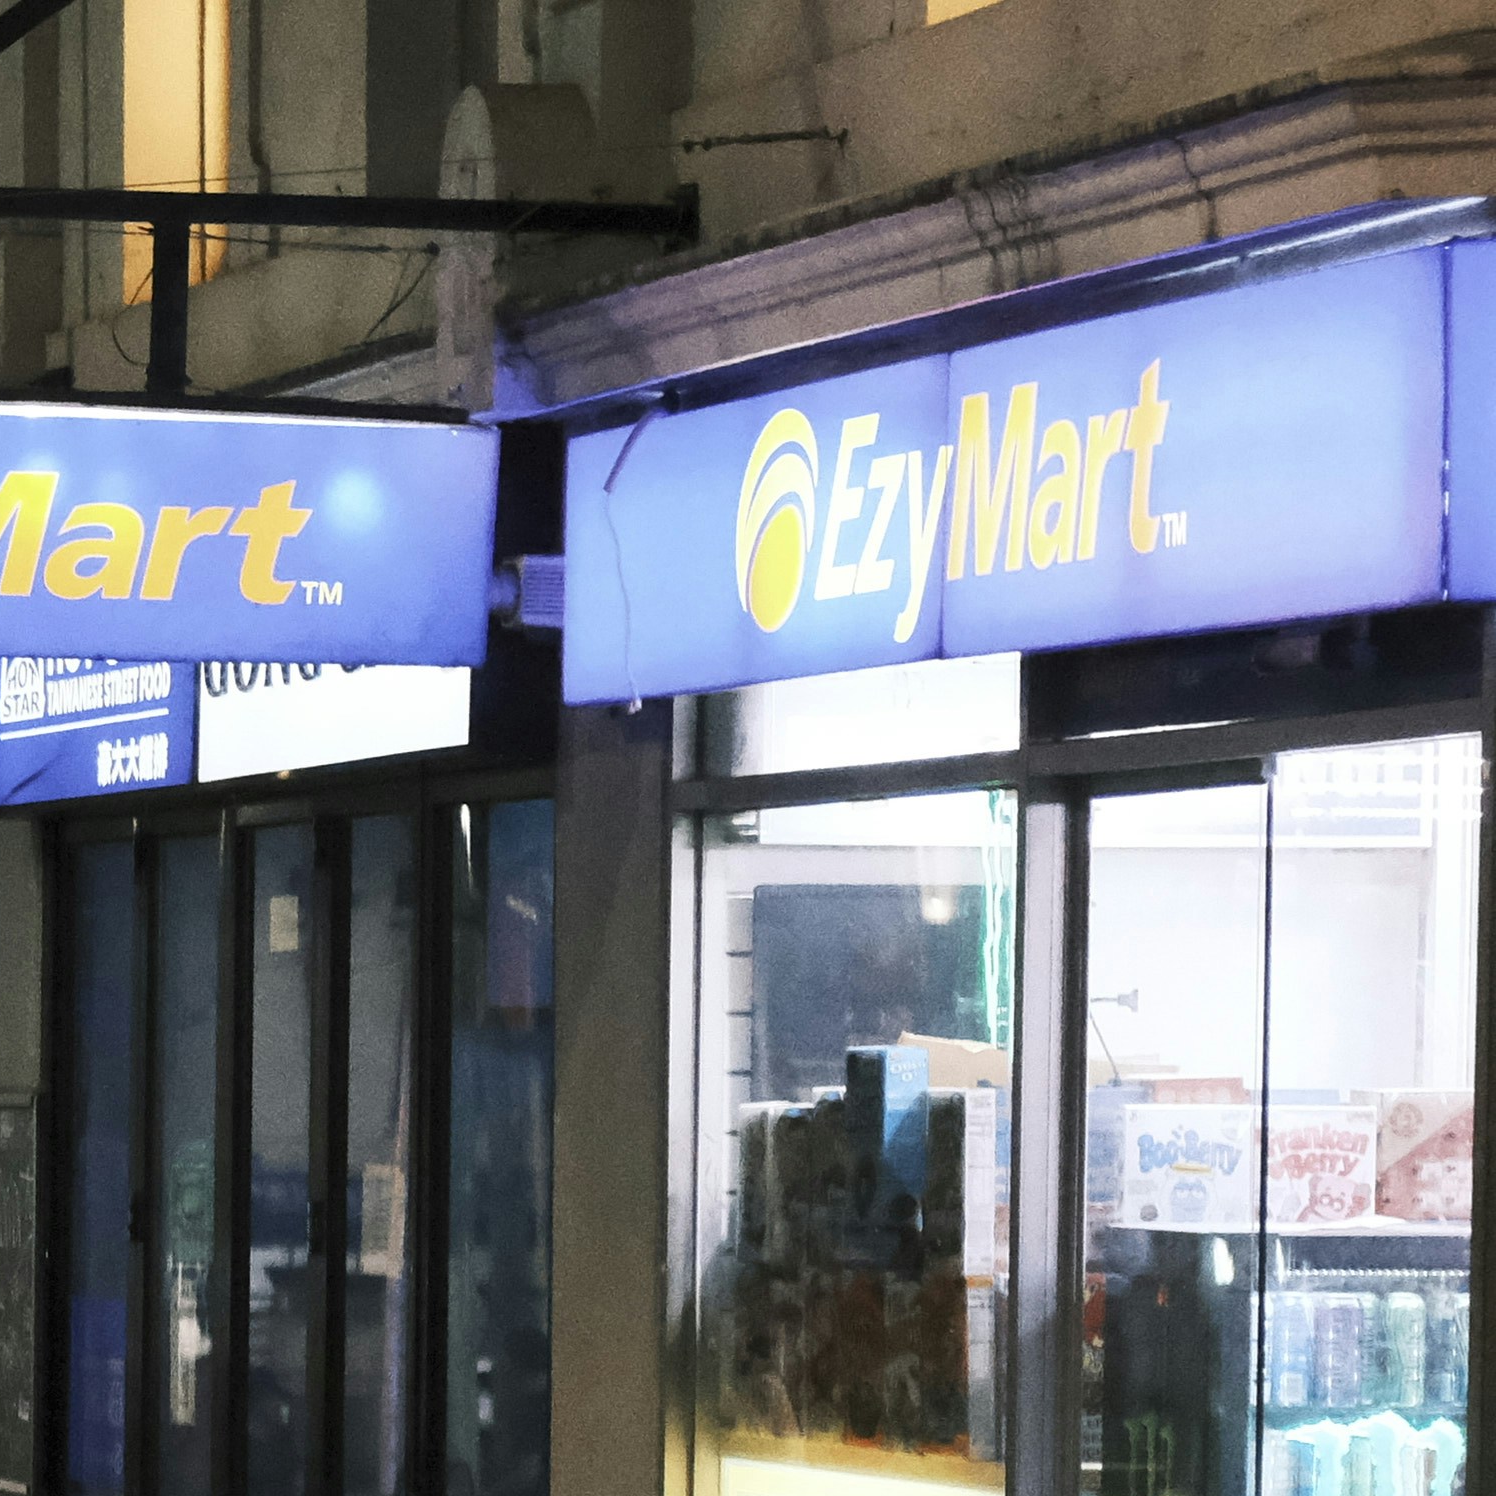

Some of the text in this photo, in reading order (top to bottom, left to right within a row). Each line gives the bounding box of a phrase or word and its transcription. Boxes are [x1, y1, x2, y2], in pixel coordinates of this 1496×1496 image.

[814, 357, 1170, 643] EzyMart
[139, 662, 171, 702] FOOD
[2, 691, 41, 718] STAR
